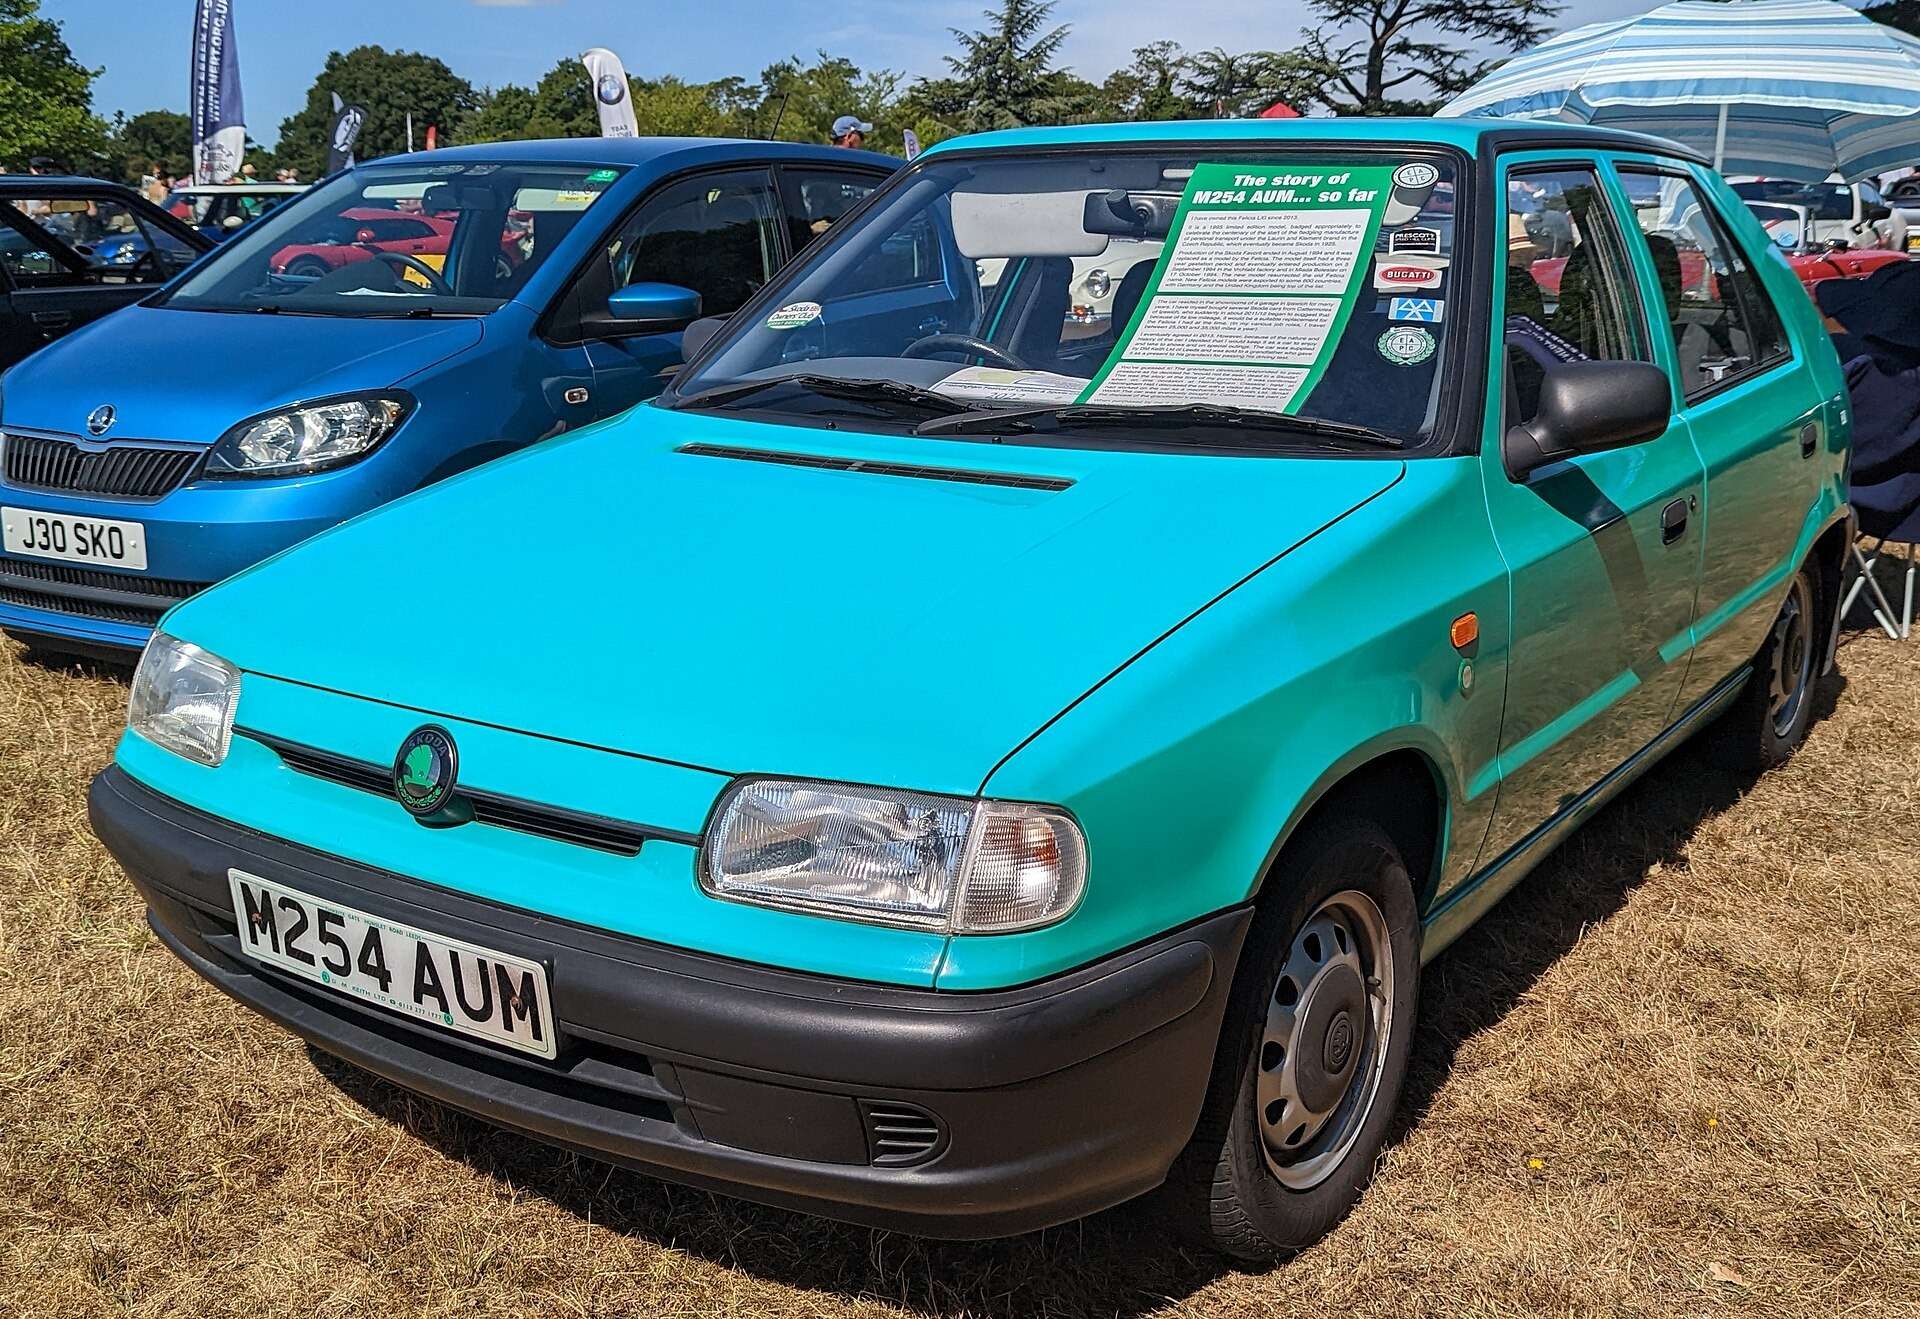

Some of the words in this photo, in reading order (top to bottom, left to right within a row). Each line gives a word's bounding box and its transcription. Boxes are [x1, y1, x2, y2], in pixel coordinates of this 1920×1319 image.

[1233, 174, 1266, 187] The
[1270, 174, 1323, 188] story
[1327, 172, 1351, 185] of
[1191, 190, 1246, 204] M254
[1249, 189, 1311, 204] AUM...
[1318, 190, 1343, 202] so
[1346, 188, 1378, 202] far
[1387, 271, 1431, 279] BUGATTI
[23, 517, 66, 552] J30
[406, 932, 422, 941] LEEDS
[240, 881, 392, 993] M254
[413, 941, 543, 1042] AUM
[352, 986, 371, 997] KEITH
